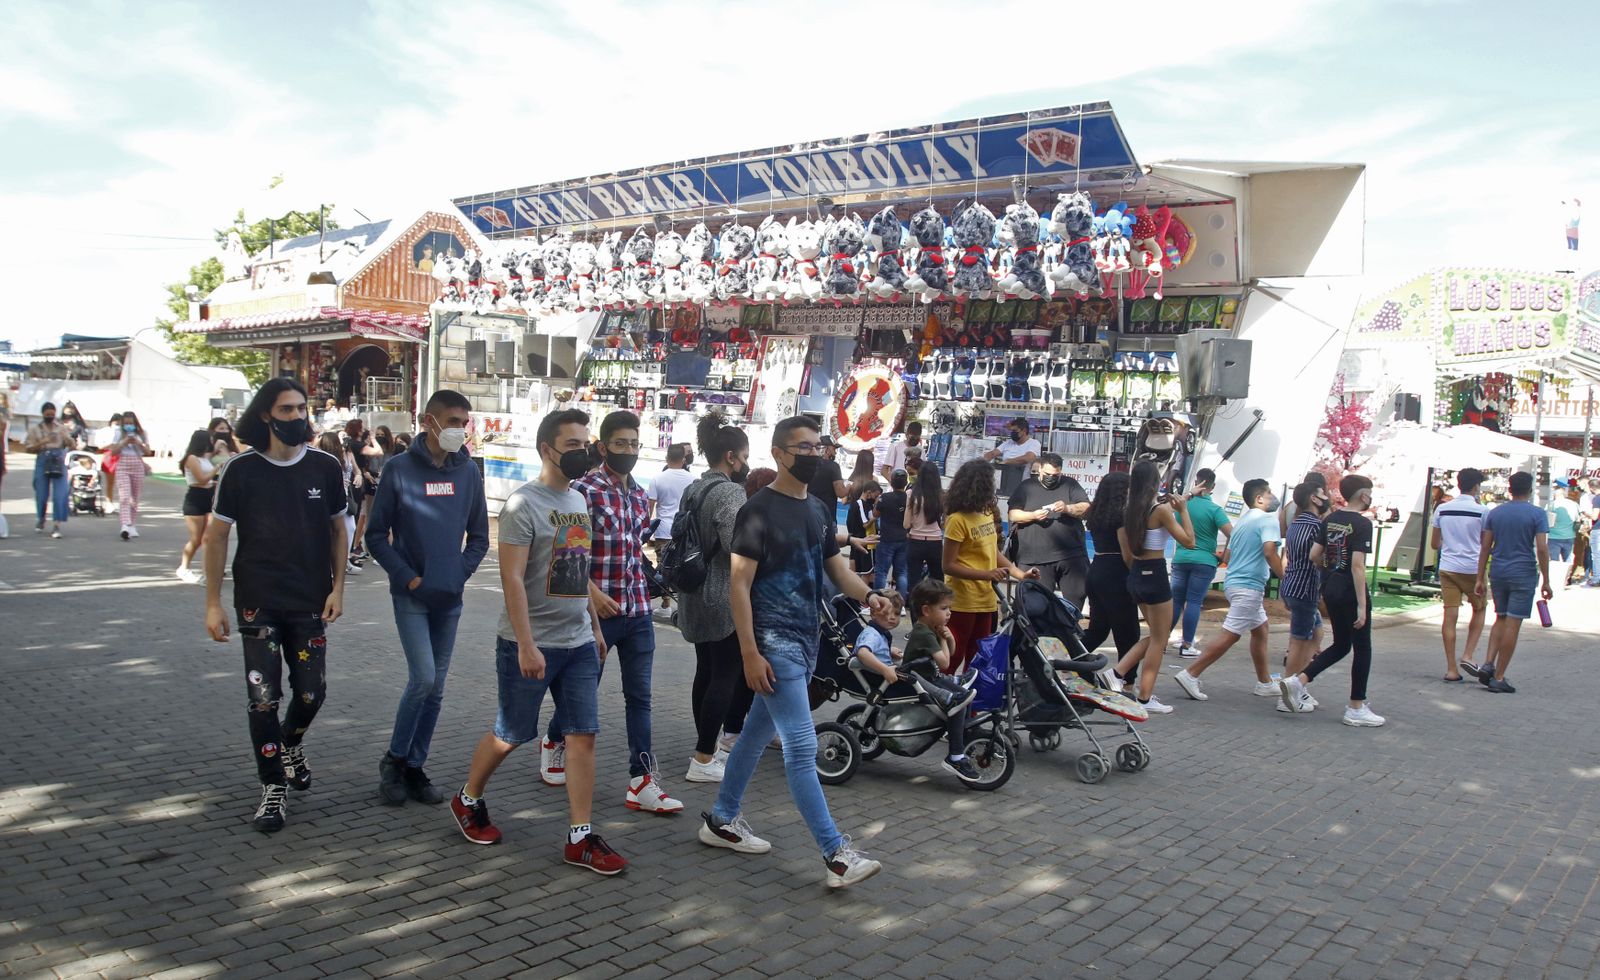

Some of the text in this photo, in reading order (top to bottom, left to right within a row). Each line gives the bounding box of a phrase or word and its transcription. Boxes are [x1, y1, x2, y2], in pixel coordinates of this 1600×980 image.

[511, 134, 988, 226] GRAN BAZAR TOMBOLAY
[1449, 279, 1501, 311] LOS
[1510, 281, 1563, 312] DOS
[1453, 315, 1551, 356] MAÑOS
[426, 482, 455, 496] MARVEL
